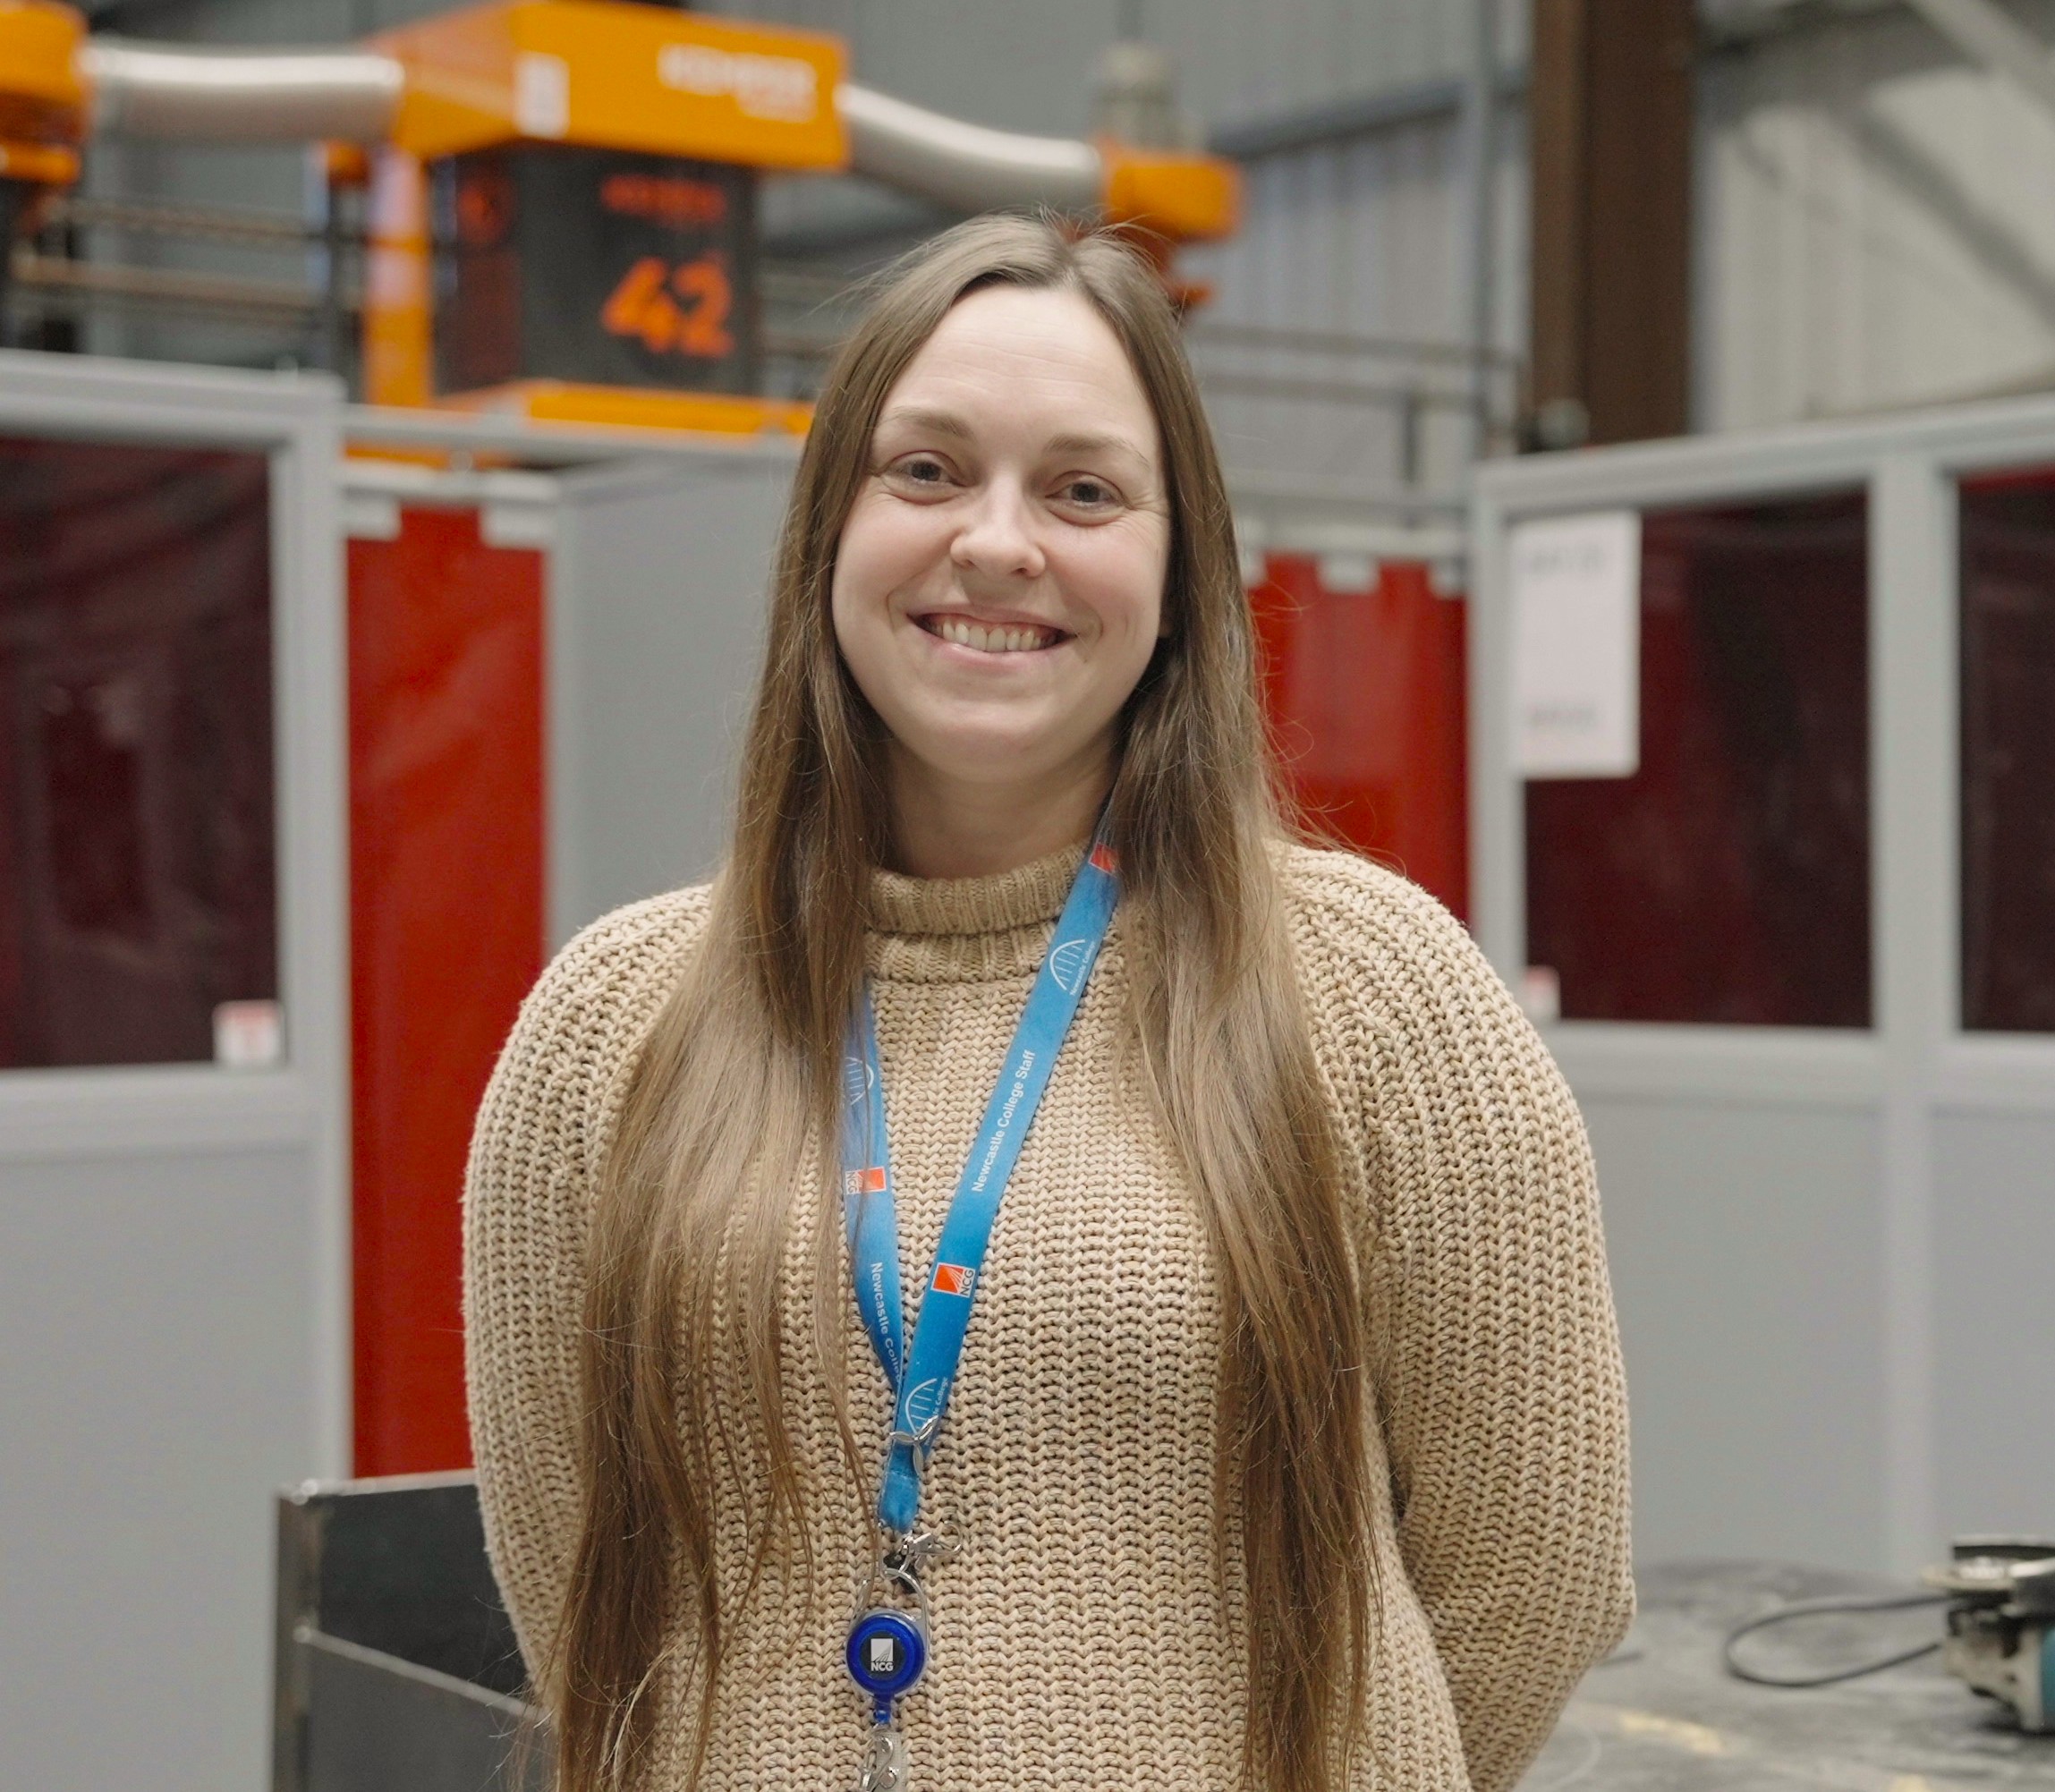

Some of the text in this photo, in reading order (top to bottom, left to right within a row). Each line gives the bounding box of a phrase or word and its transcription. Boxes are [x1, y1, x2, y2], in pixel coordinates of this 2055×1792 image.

[602, 257, 732, 358] 42
[972, 1049, 1036, 1193] Newcastle College Staff
[870, 1261, 889, 1335] Newcastle
[959, 1270, 974, 1296] NCG
[870, 1661, 895, 1672] NCG
